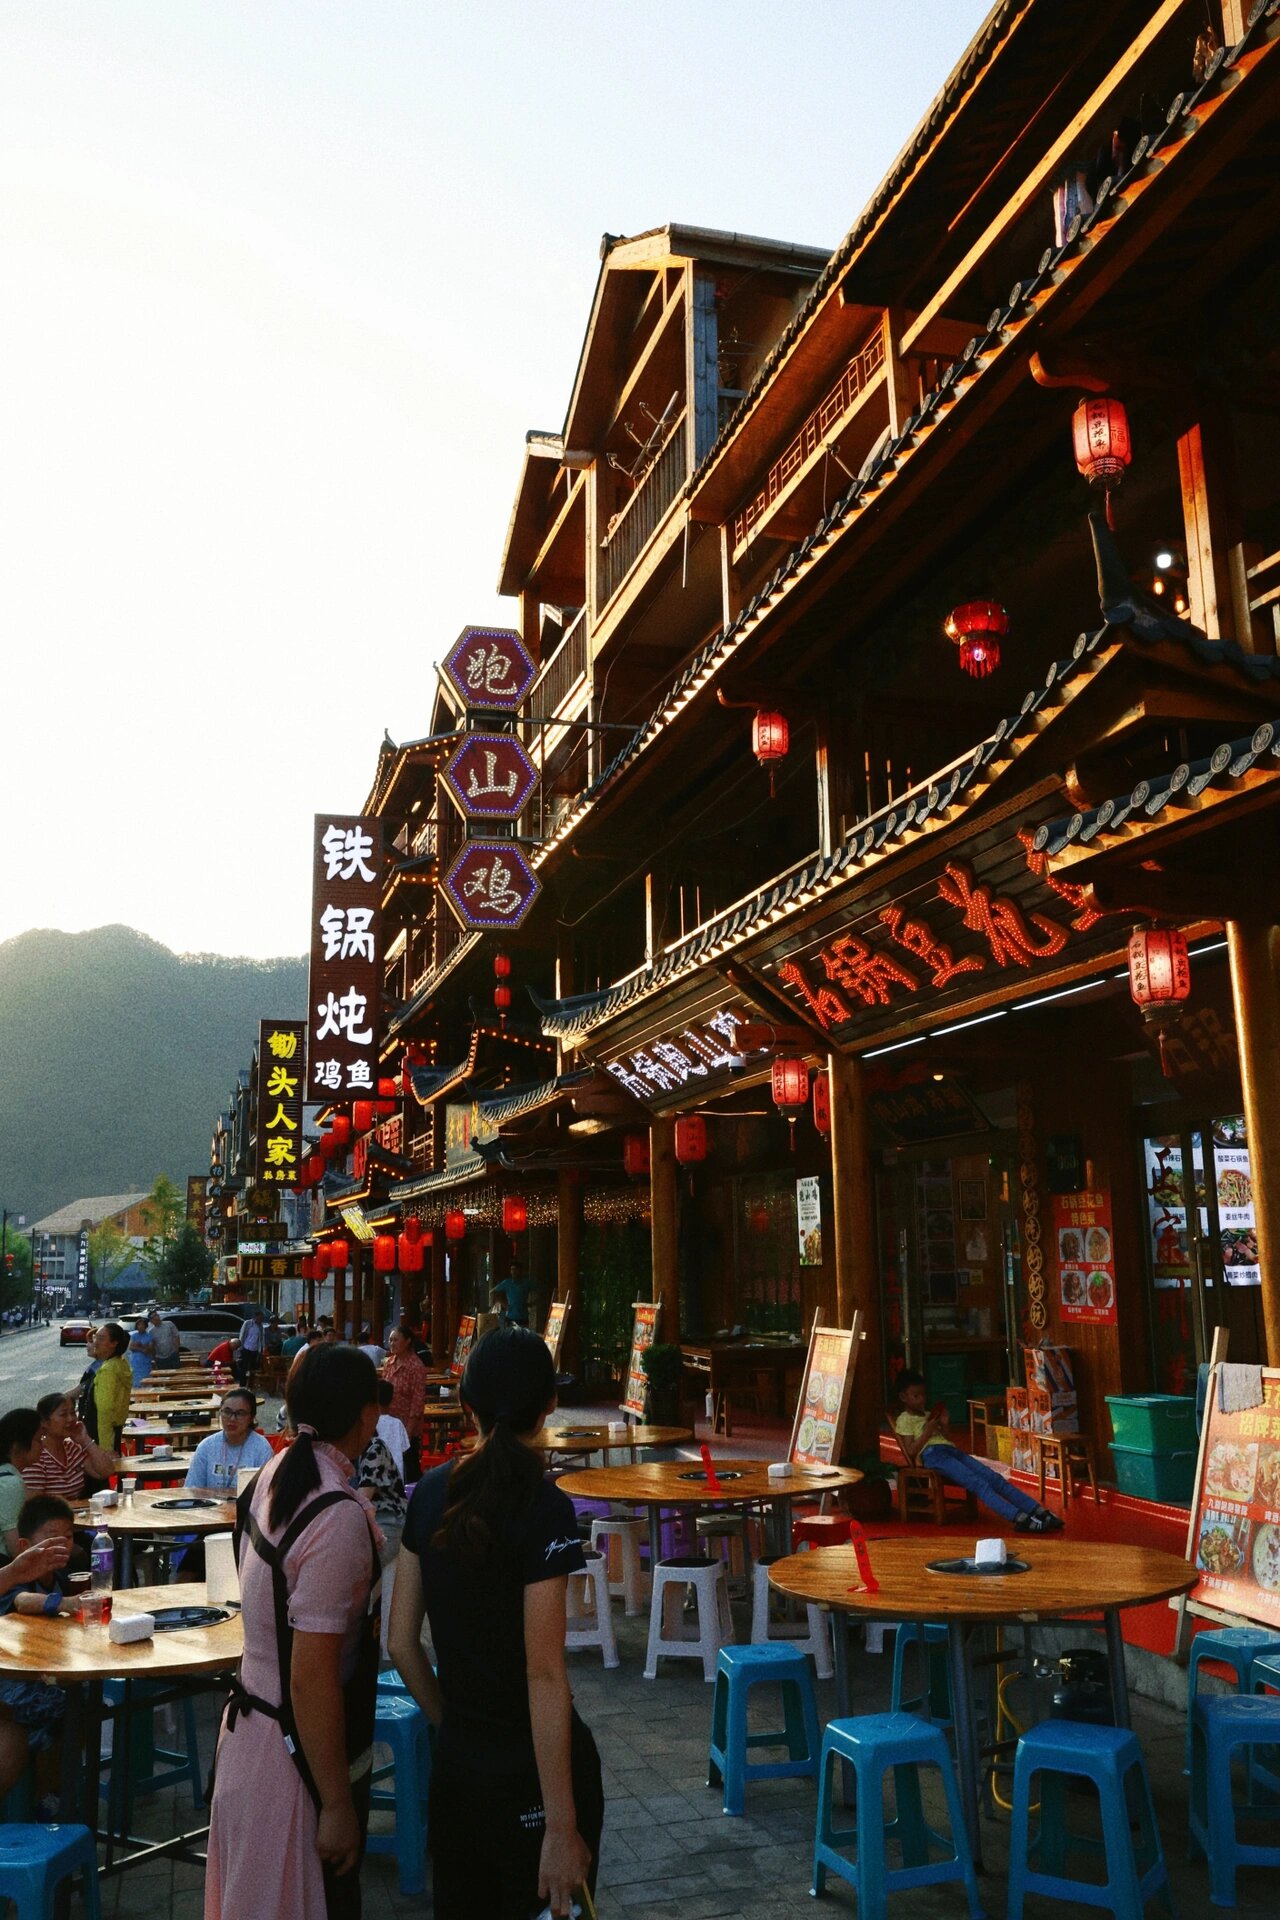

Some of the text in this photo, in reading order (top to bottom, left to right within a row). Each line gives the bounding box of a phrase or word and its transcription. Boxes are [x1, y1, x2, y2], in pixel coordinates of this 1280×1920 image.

[463, 643, 523, 914] 跑山鸡
[316, 824, 377, 1045] 铁锅炖
[265, 1030, 299, 1166] 锄头人家
[314, 1057, 375, 1090] 鸡鱼
[262, 1169, 298, 1182] 私房菜
[1217, 1154, 1249, 1164] 酸菜石锅鱼
